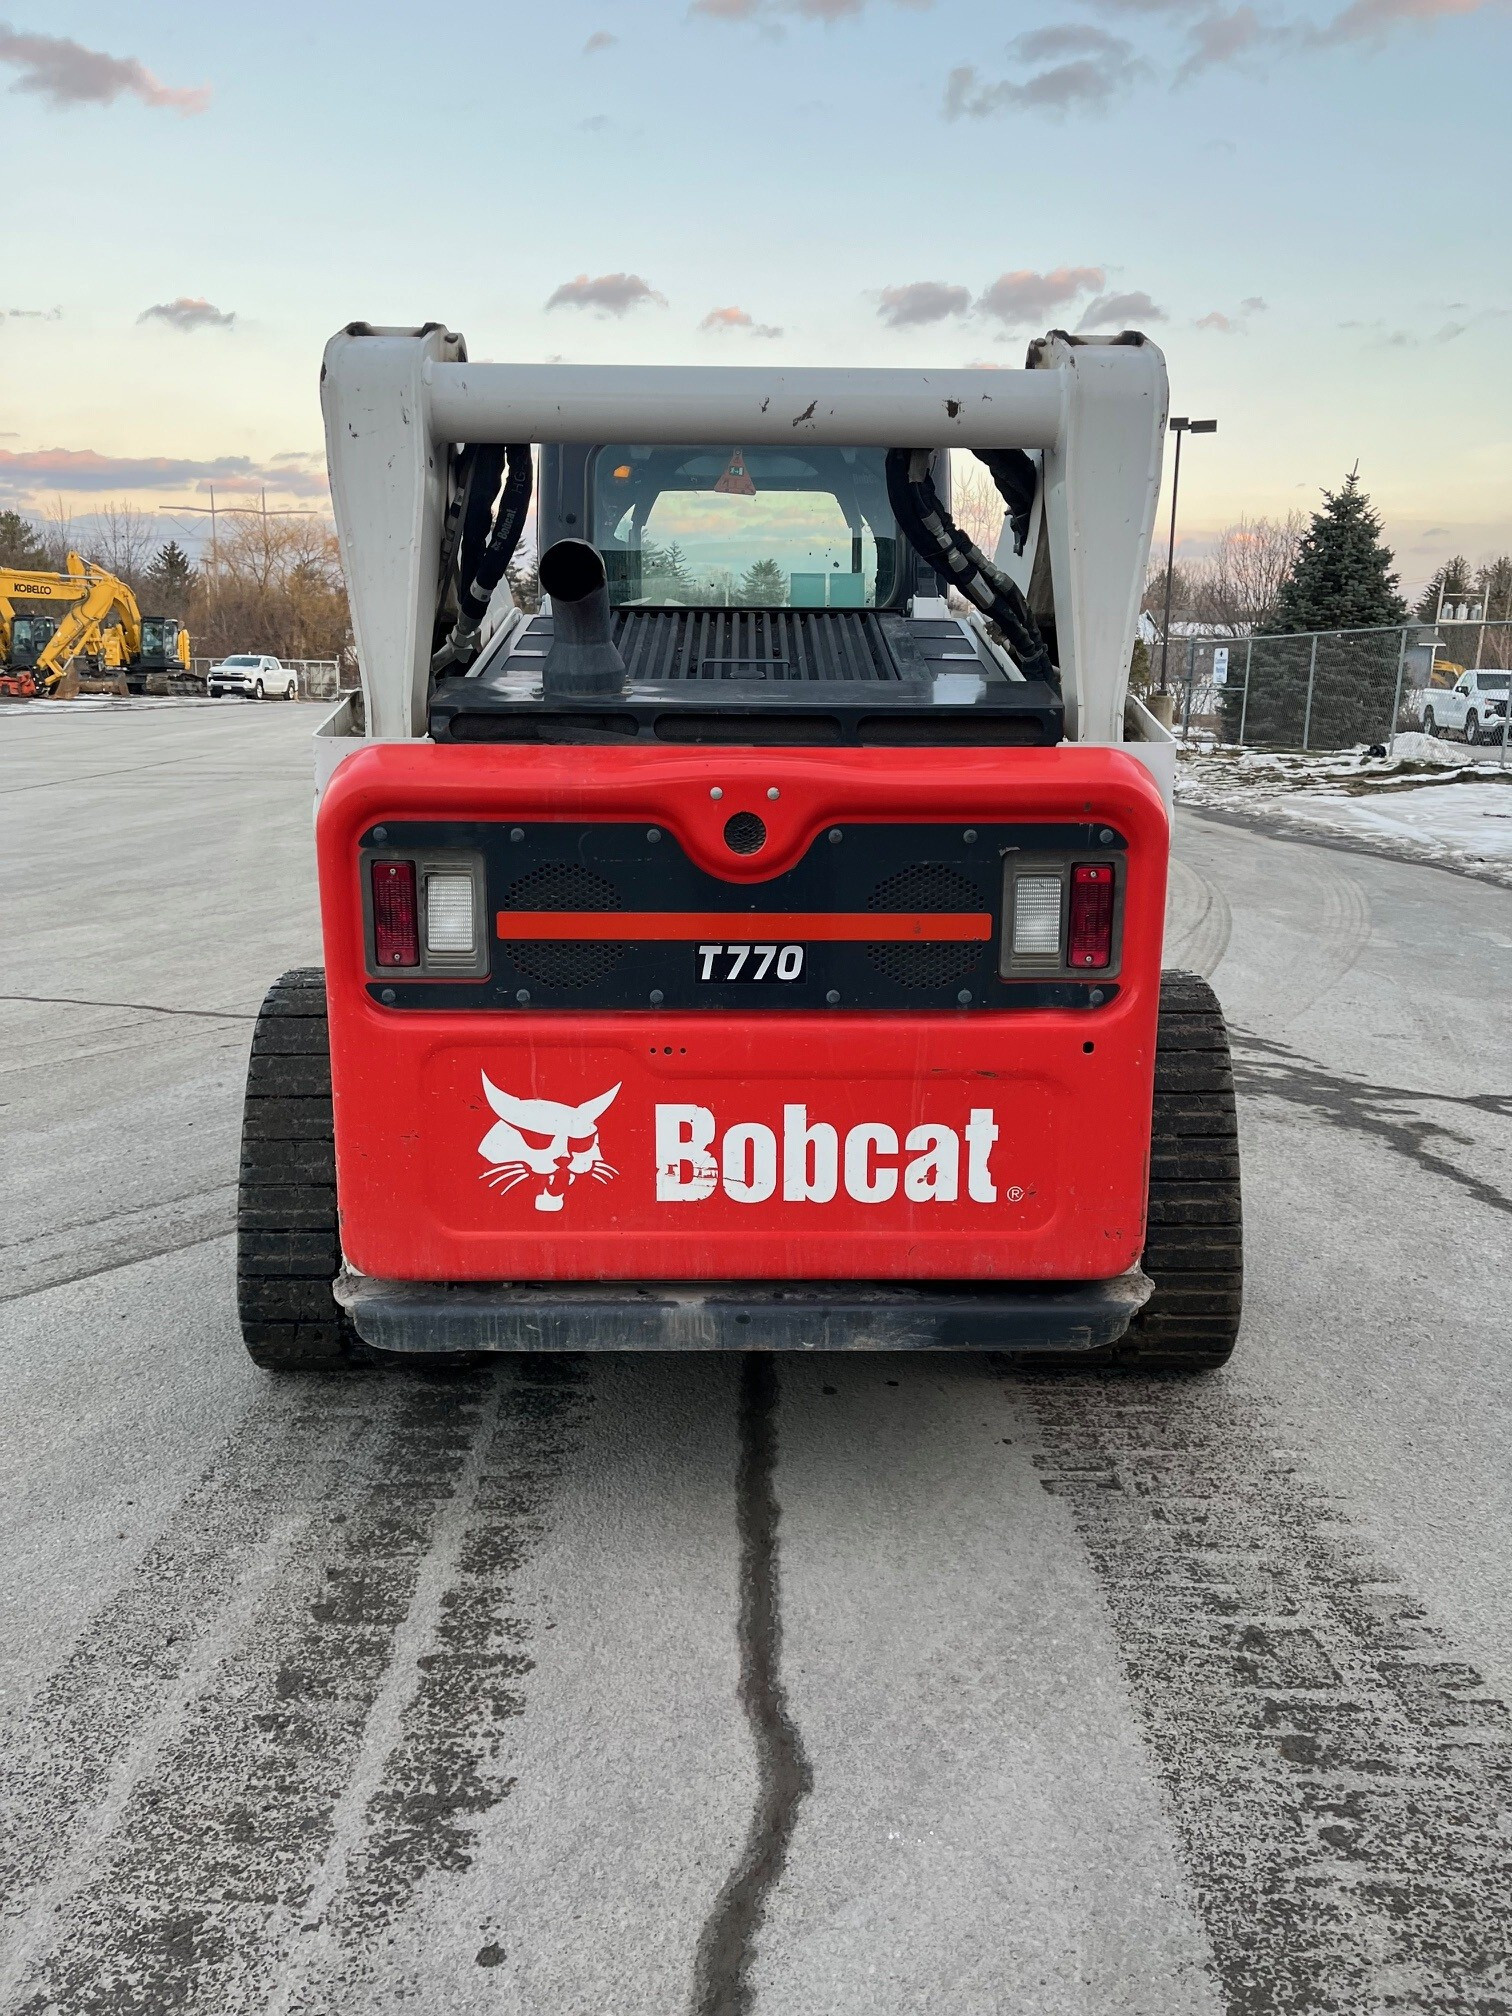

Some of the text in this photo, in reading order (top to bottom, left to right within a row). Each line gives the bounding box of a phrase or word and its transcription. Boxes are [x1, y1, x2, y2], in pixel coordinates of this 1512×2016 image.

[497, 508, 517, 540] Bobcat
[14, 583, 52, 595] KOBELCO
[699, 945, 804, 980] T770
[655, 1103, 999, 1203] Bobcat
